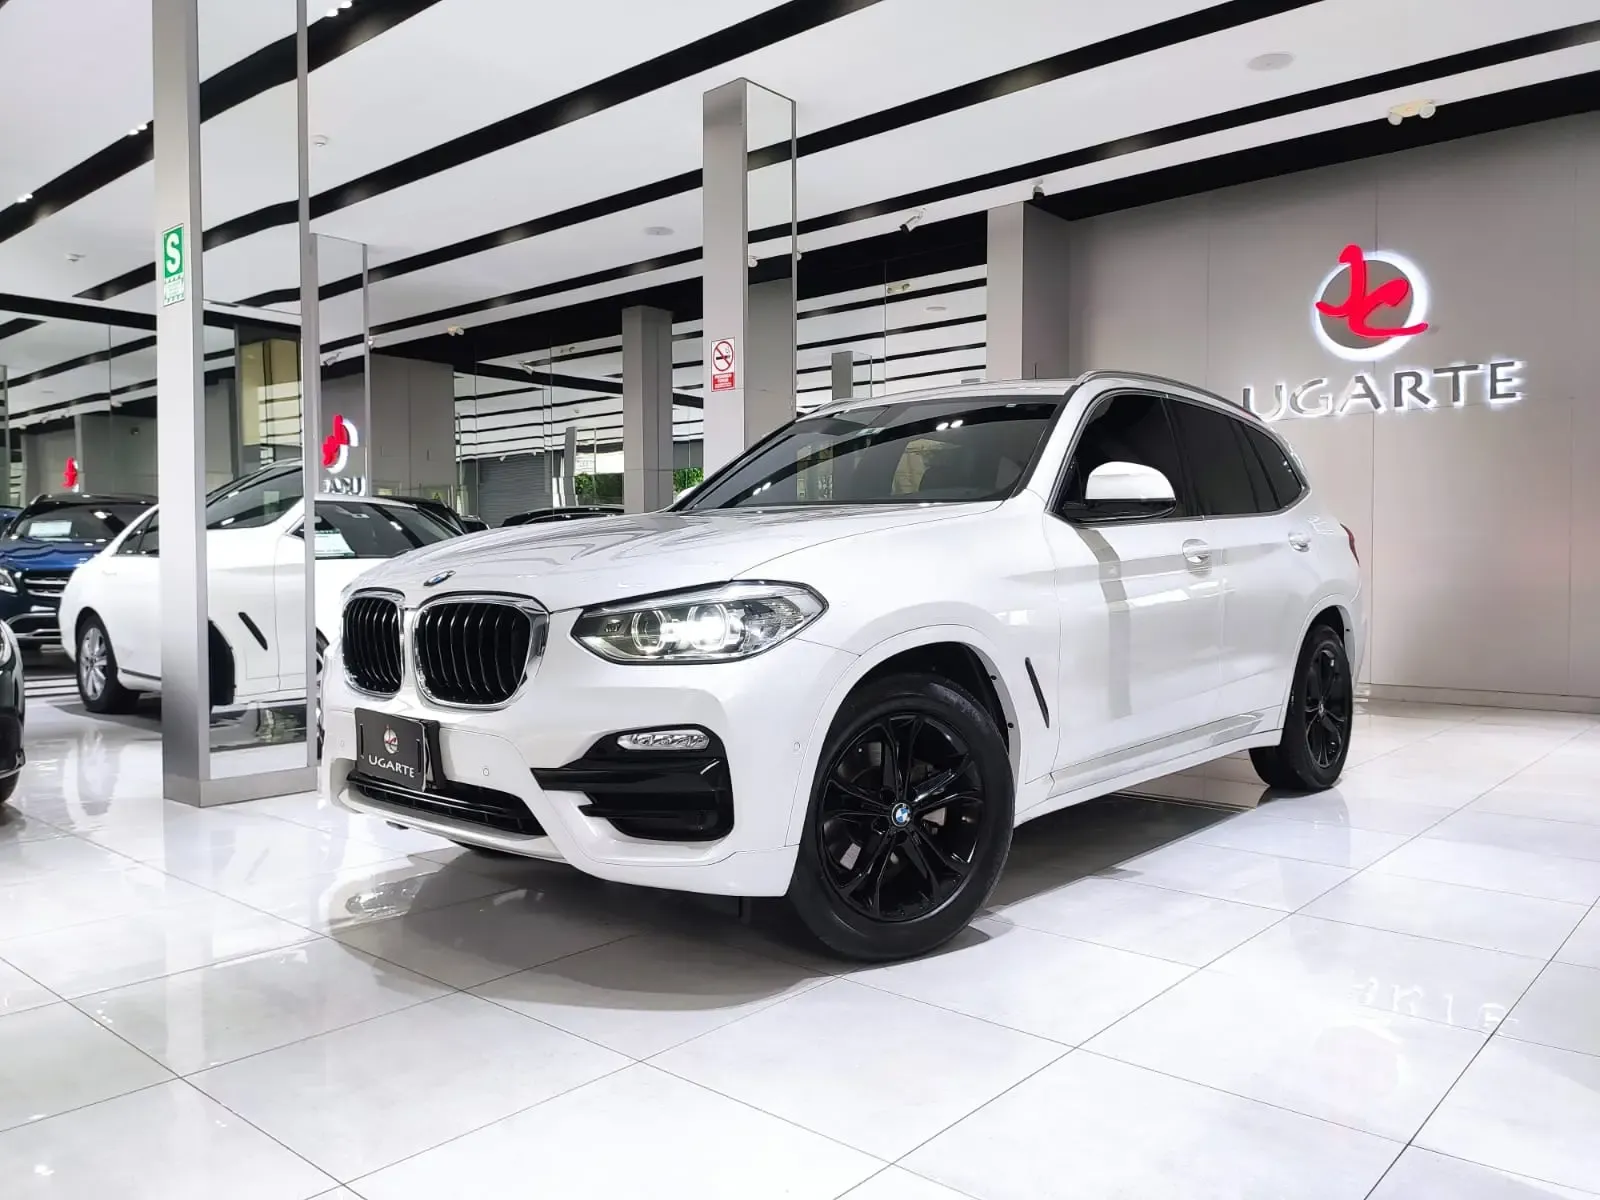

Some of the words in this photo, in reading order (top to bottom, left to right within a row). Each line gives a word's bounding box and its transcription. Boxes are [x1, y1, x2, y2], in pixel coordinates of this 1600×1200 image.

[166, 233, 181, 274] S
[1242, 360, 1524, 421] UGARTE
[368, 754, 415, 778] UGARTE
